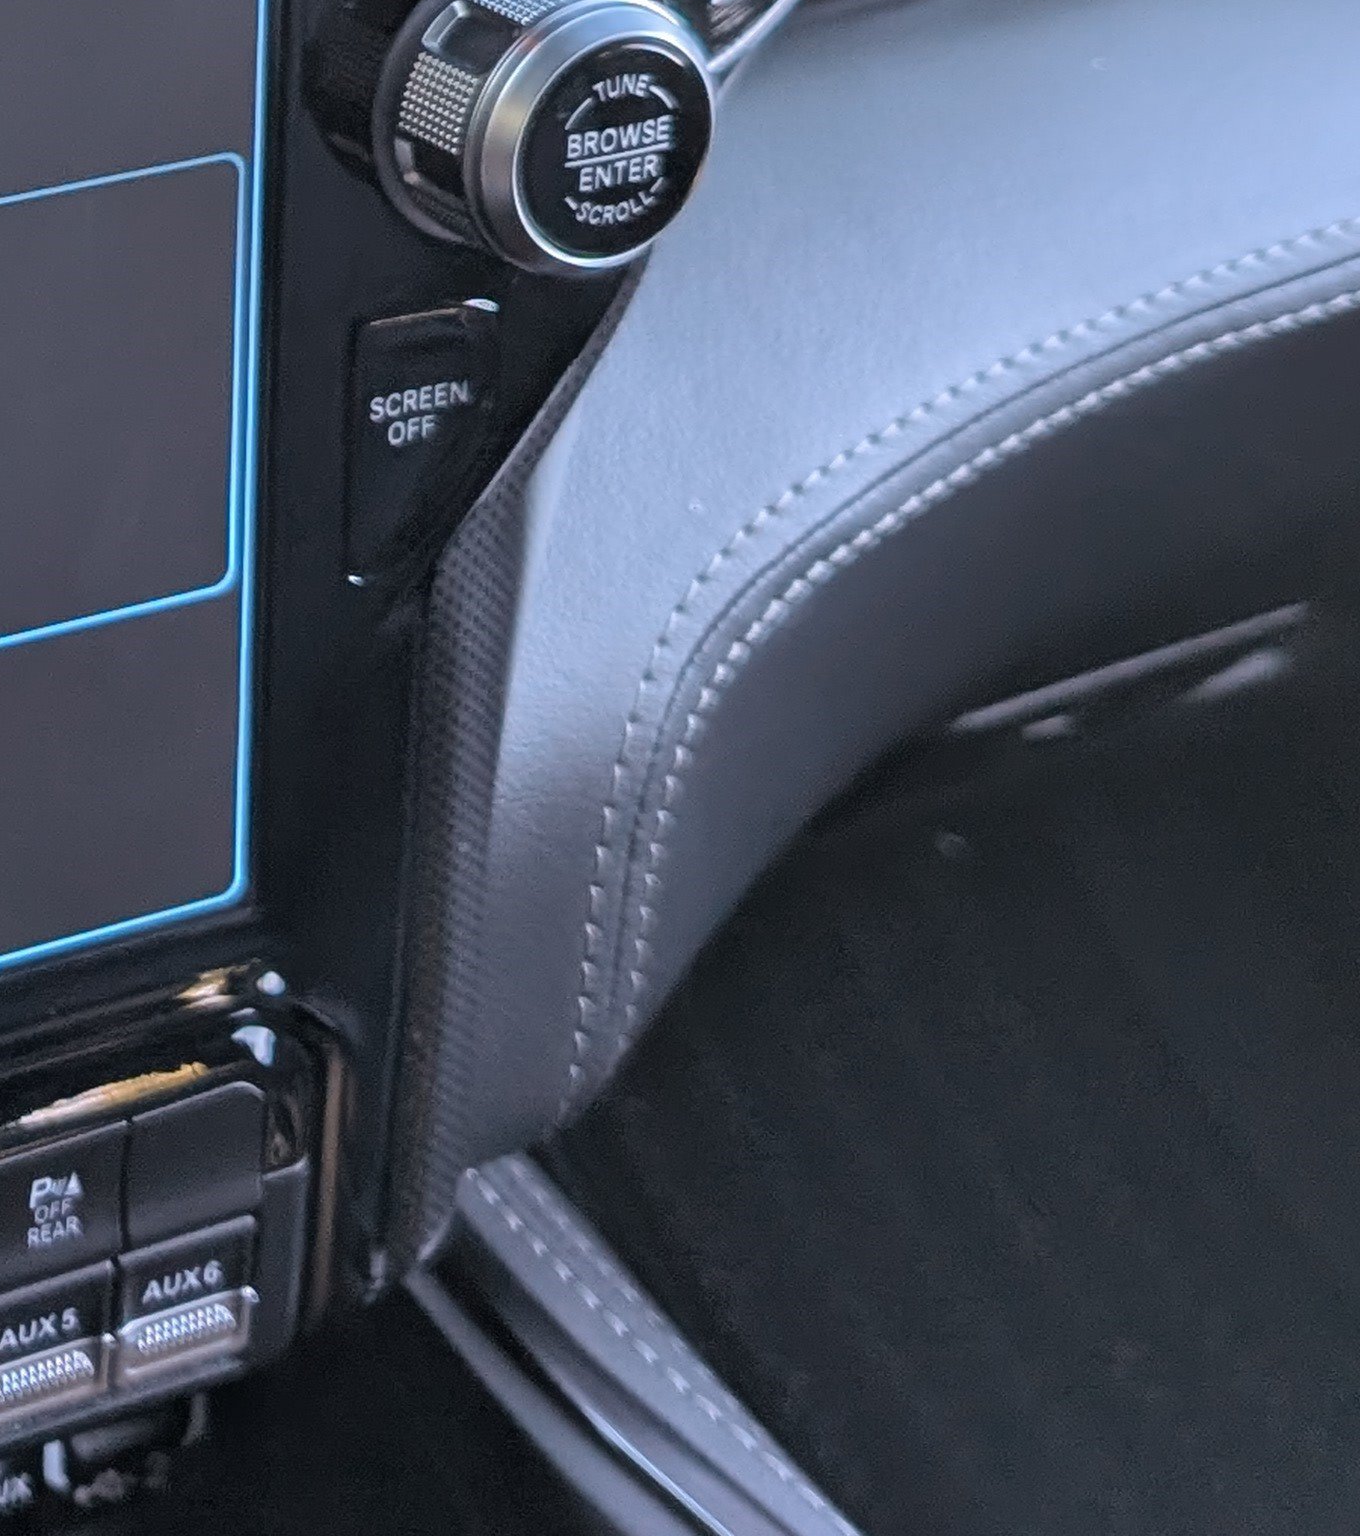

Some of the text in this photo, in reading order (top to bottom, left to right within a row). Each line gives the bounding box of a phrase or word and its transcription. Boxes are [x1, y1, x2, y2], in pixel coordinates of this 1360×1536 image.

[592, 73, 651, 103] TUNE
[567, 114, 674, 160] BROWSE
[579, 154, 660, 193] ENTER
[576, 190, 656, 226] SCROLL
[369, 379, 470, 424] SCREEN
[387, 415, 437, 448] OFF
[34, 1198, 73, 1225] OFF
[26, 1216, 82, 1248] REAR
[142, 1260, 225, 1304] AUX 6
[61, 1307, 80, 1332] 5
